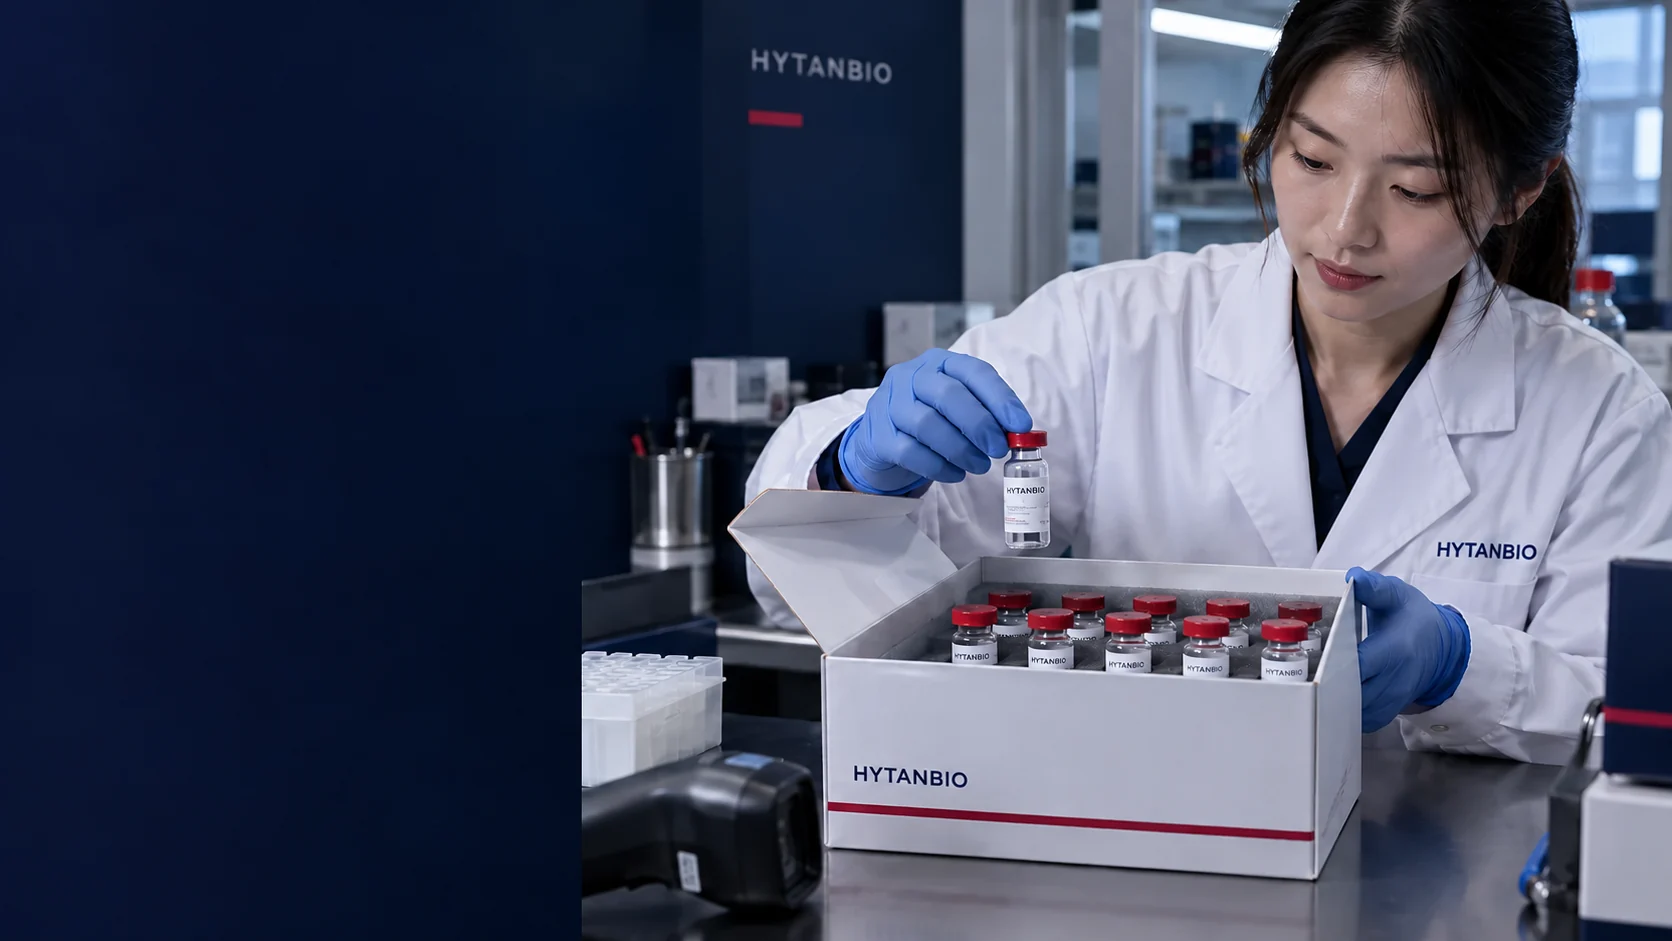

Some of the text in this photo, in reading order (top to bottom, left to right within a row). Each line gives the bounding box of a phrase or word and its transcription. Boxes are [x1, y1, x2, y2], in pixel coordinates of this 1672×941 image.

[751, 48, 892, 85] HYTANBIO
[1006, 486, 1045, 495] HYTANBIO
[1437, 541, 1537, 560] HYTANBIO
[954, 653, 990, 661] HYTANBIO
[1031, 657, 1067, 665] HYTANBIO
[1108, 661, 1144, 669] HYTANBIO
[1187, 664, 1223, 673] HYTANBIO
[1265, 668, 1303, 677] HYTANBIO
[853, 765, 968, 788] HYTANBIO
